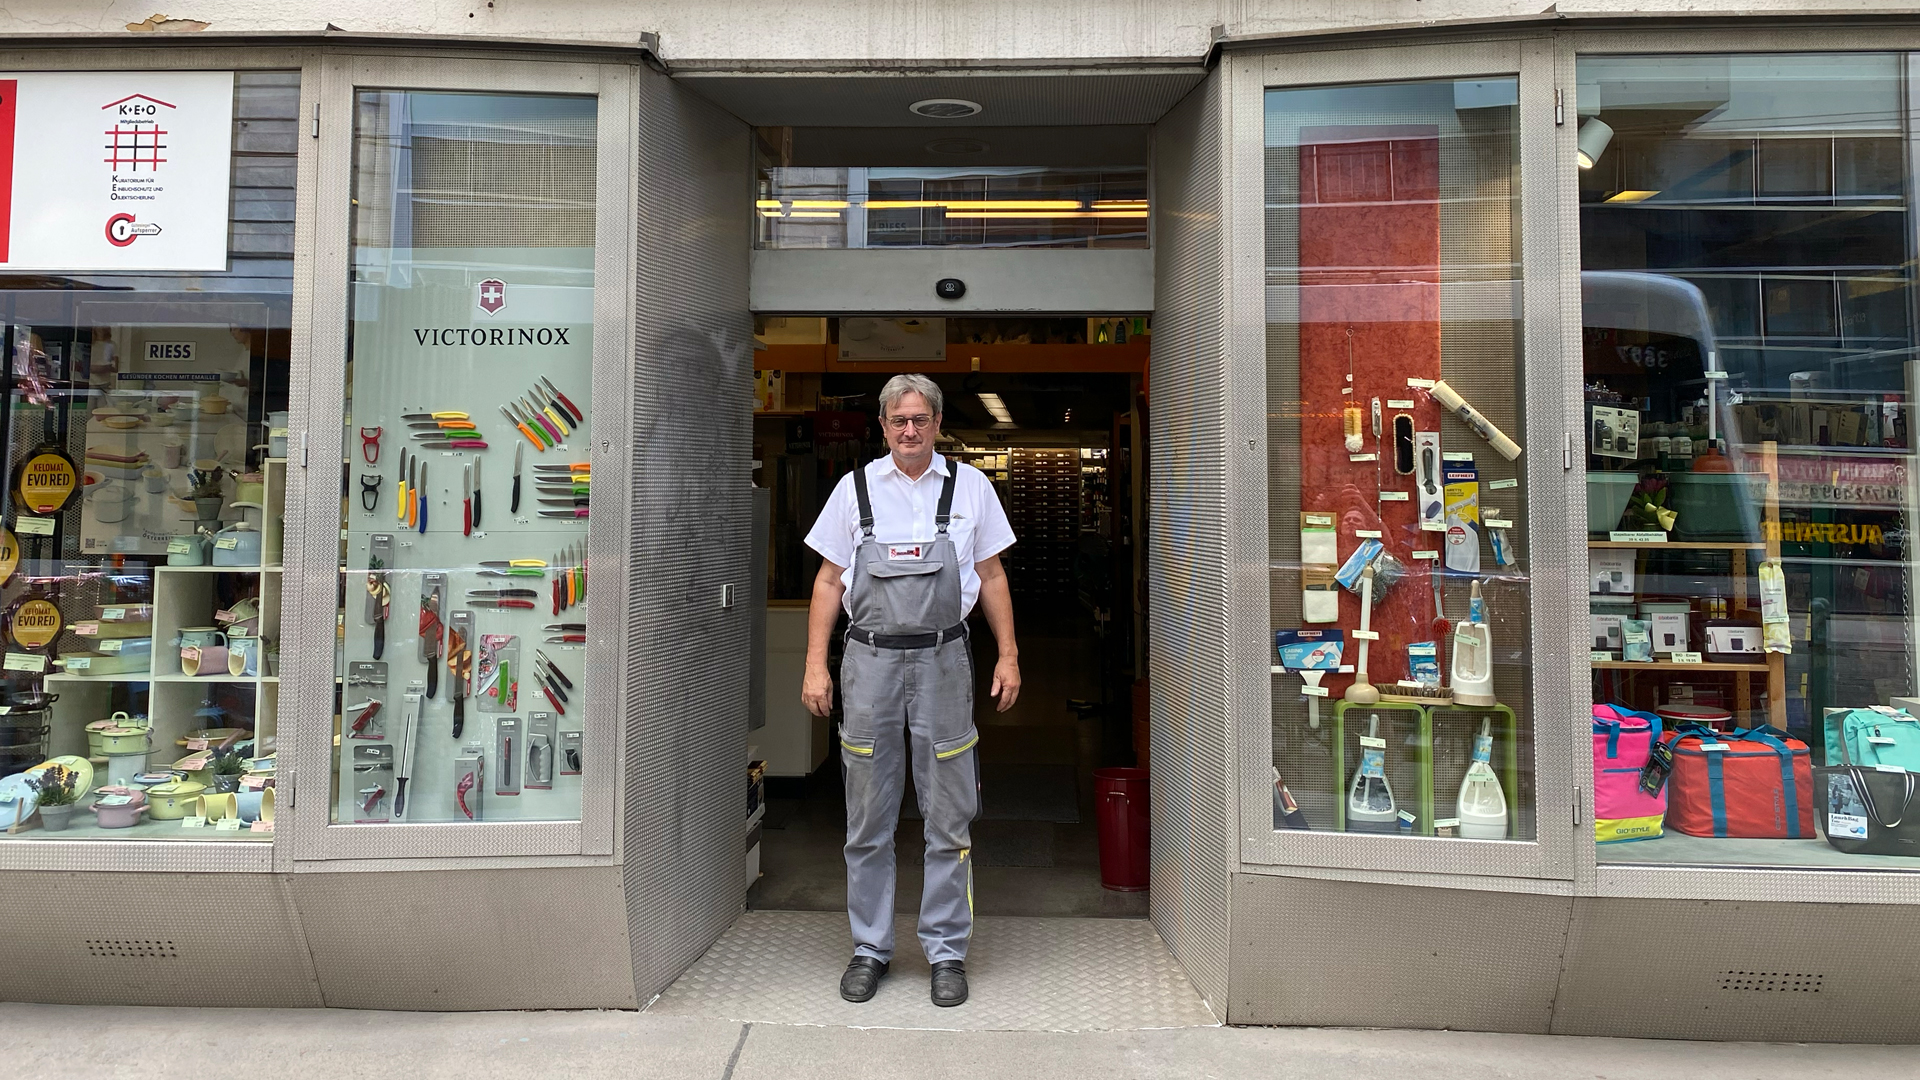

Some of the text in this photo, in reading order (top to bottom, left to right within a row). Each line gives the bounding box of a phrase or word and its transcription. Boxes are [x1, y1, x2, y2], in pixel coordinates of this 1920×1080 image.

[112, 175, 145, 183] KURATORIUM
[413, 327, 570, 346] VICTORINOX
[149, 344, 191, 358] RIESS
[33, 463, 64, 472] KELOMAT
[27, 473, 70, 486] EVO RED
[18, 615, 56, 626] EVO RED
